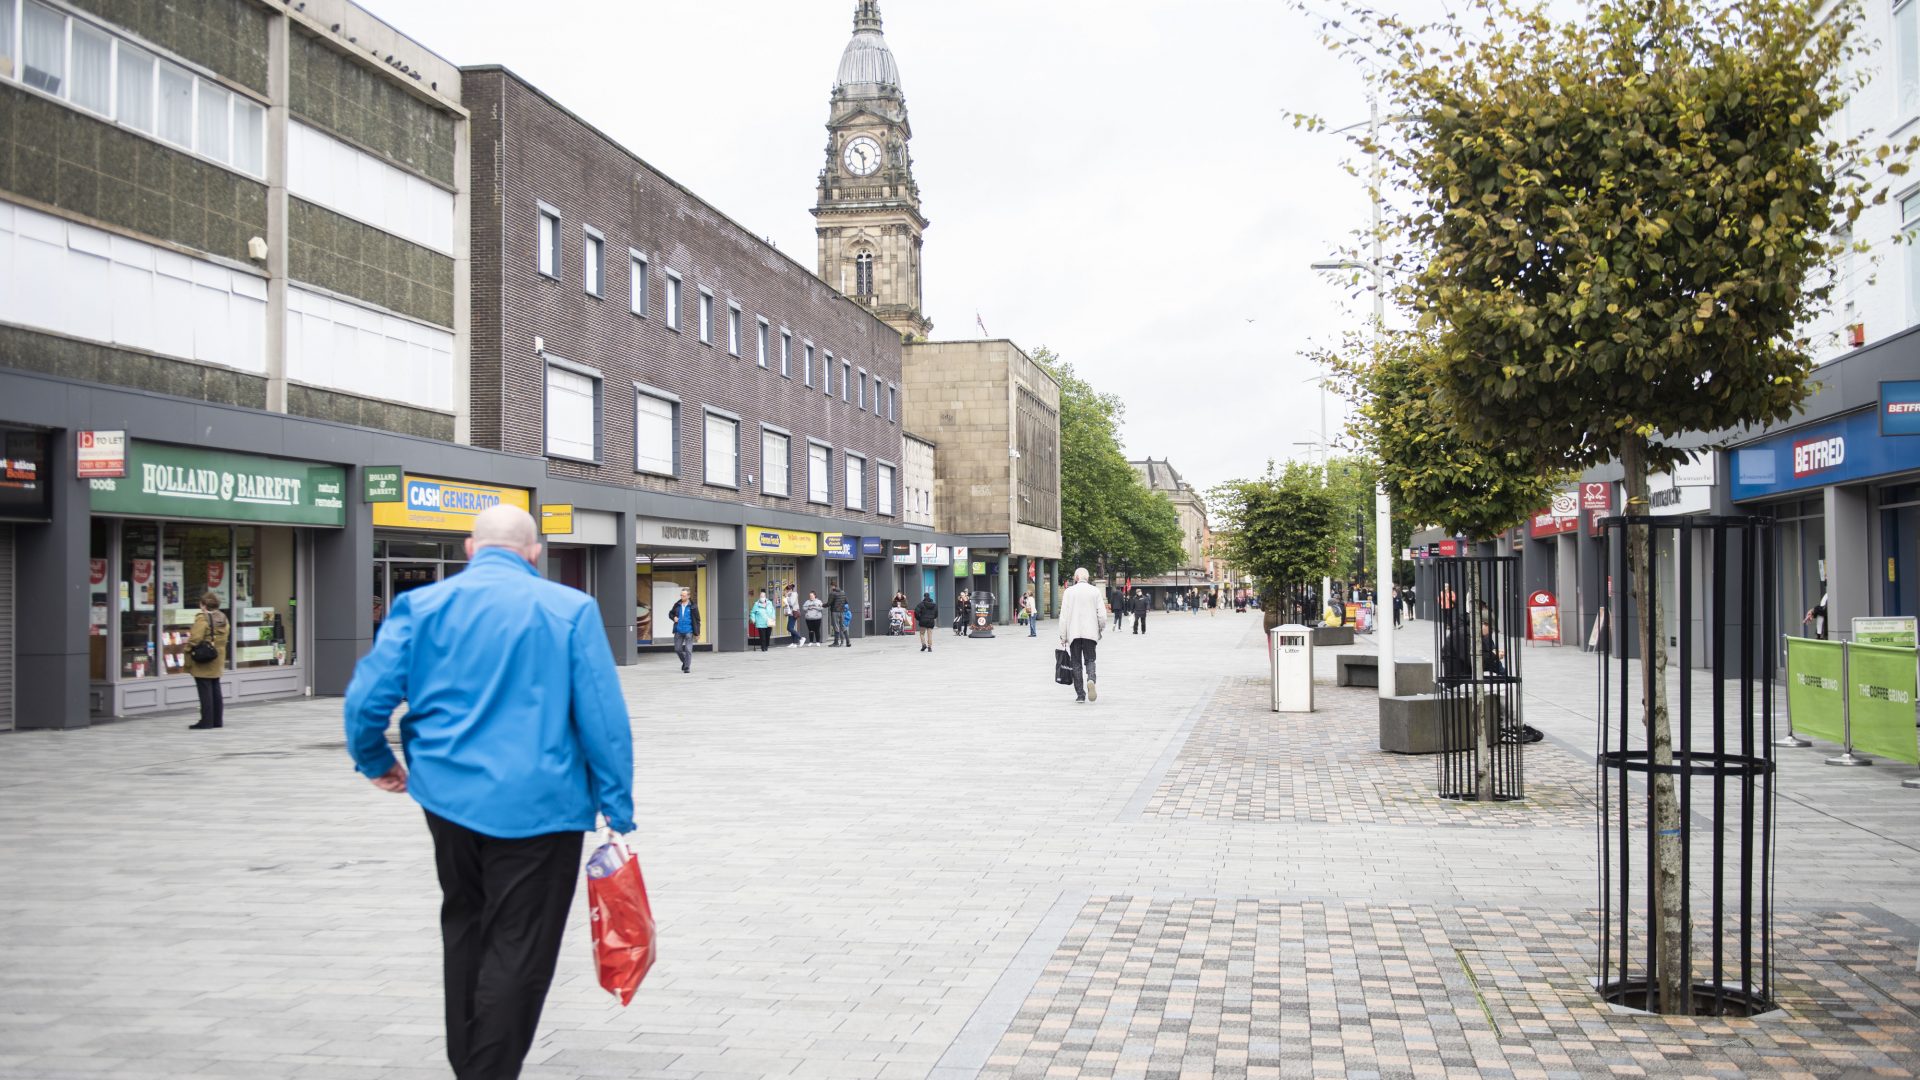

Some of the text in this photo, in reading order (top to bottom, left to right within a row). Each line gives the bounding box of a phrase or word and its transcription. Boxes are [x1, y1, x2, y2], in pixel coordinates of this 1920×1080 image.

[96, 436, 124, 445] TO LET
[1795, 436, 1845, 473] BETFRED
[142, 463, 301, 504] HOLLAND & BARRETT
[369, 473, 397, 482] HOLLAND
[369, 487, 396, 496] BARRETT
[410, 486, 500, 512] CASH GENERATOR
